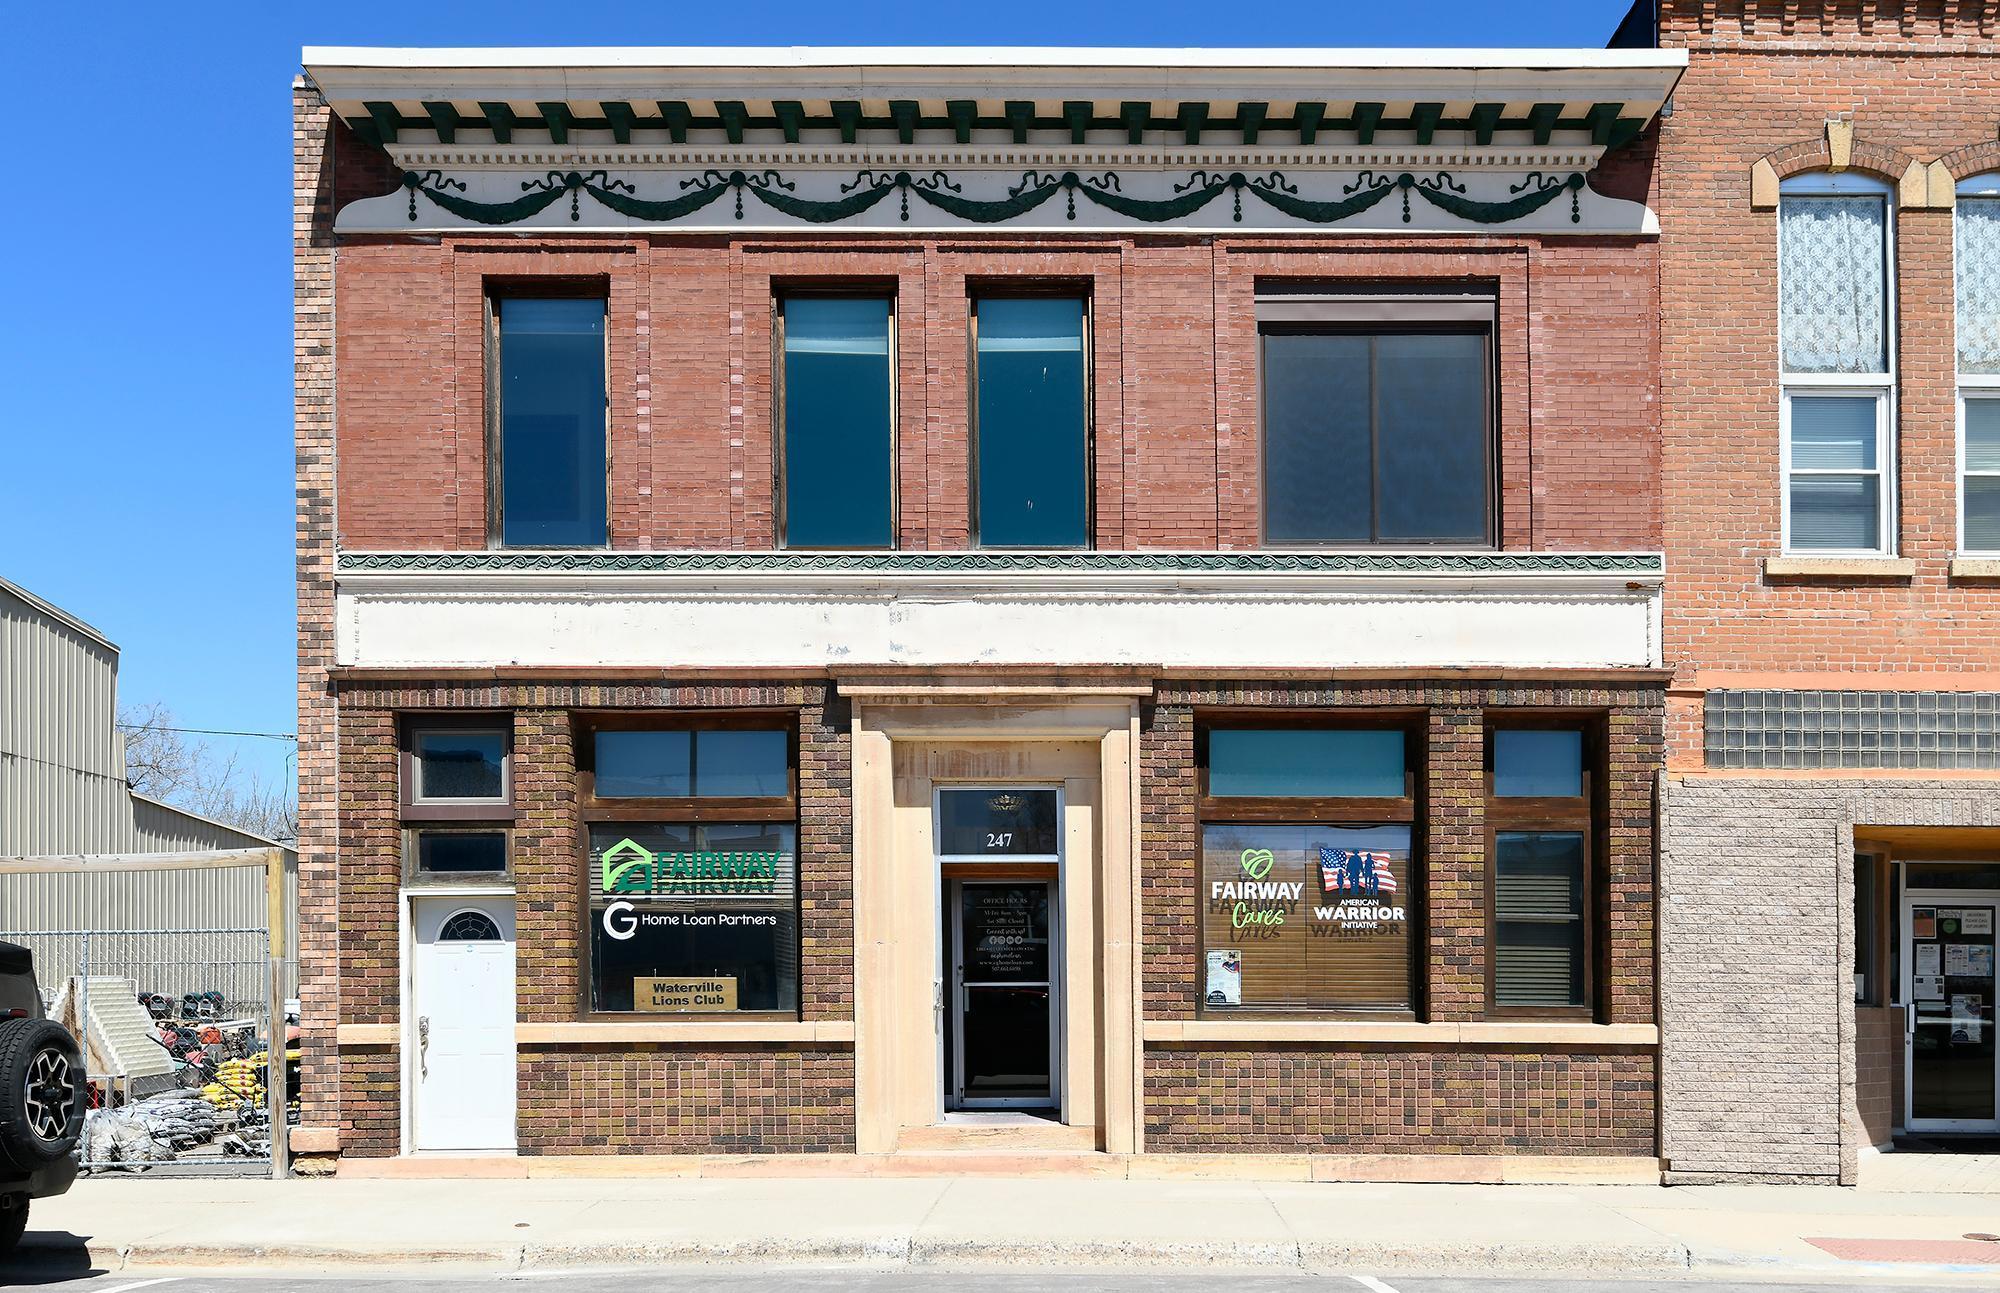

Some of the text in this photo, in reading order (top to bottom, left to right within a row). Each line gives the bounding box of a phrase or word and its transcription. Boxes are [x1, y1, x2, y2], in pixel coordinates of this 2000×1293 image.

[986, 833, 1012, 847] 247
[657, 851, 781, 876] FAIRWAY
[1212, 882, 1304, 900] FAIRWAY
[642, 914, 777, 926] Home Loan Partners
[1232, 901, 1285, 929] Cares
[1314, 907, 1405, 920] WARRIOR
[1341, 921, 1378, 929] INITIATIVE
[653, 982, 723, 993] Waterville
[652, 995, 724, 1006] Lions Club
